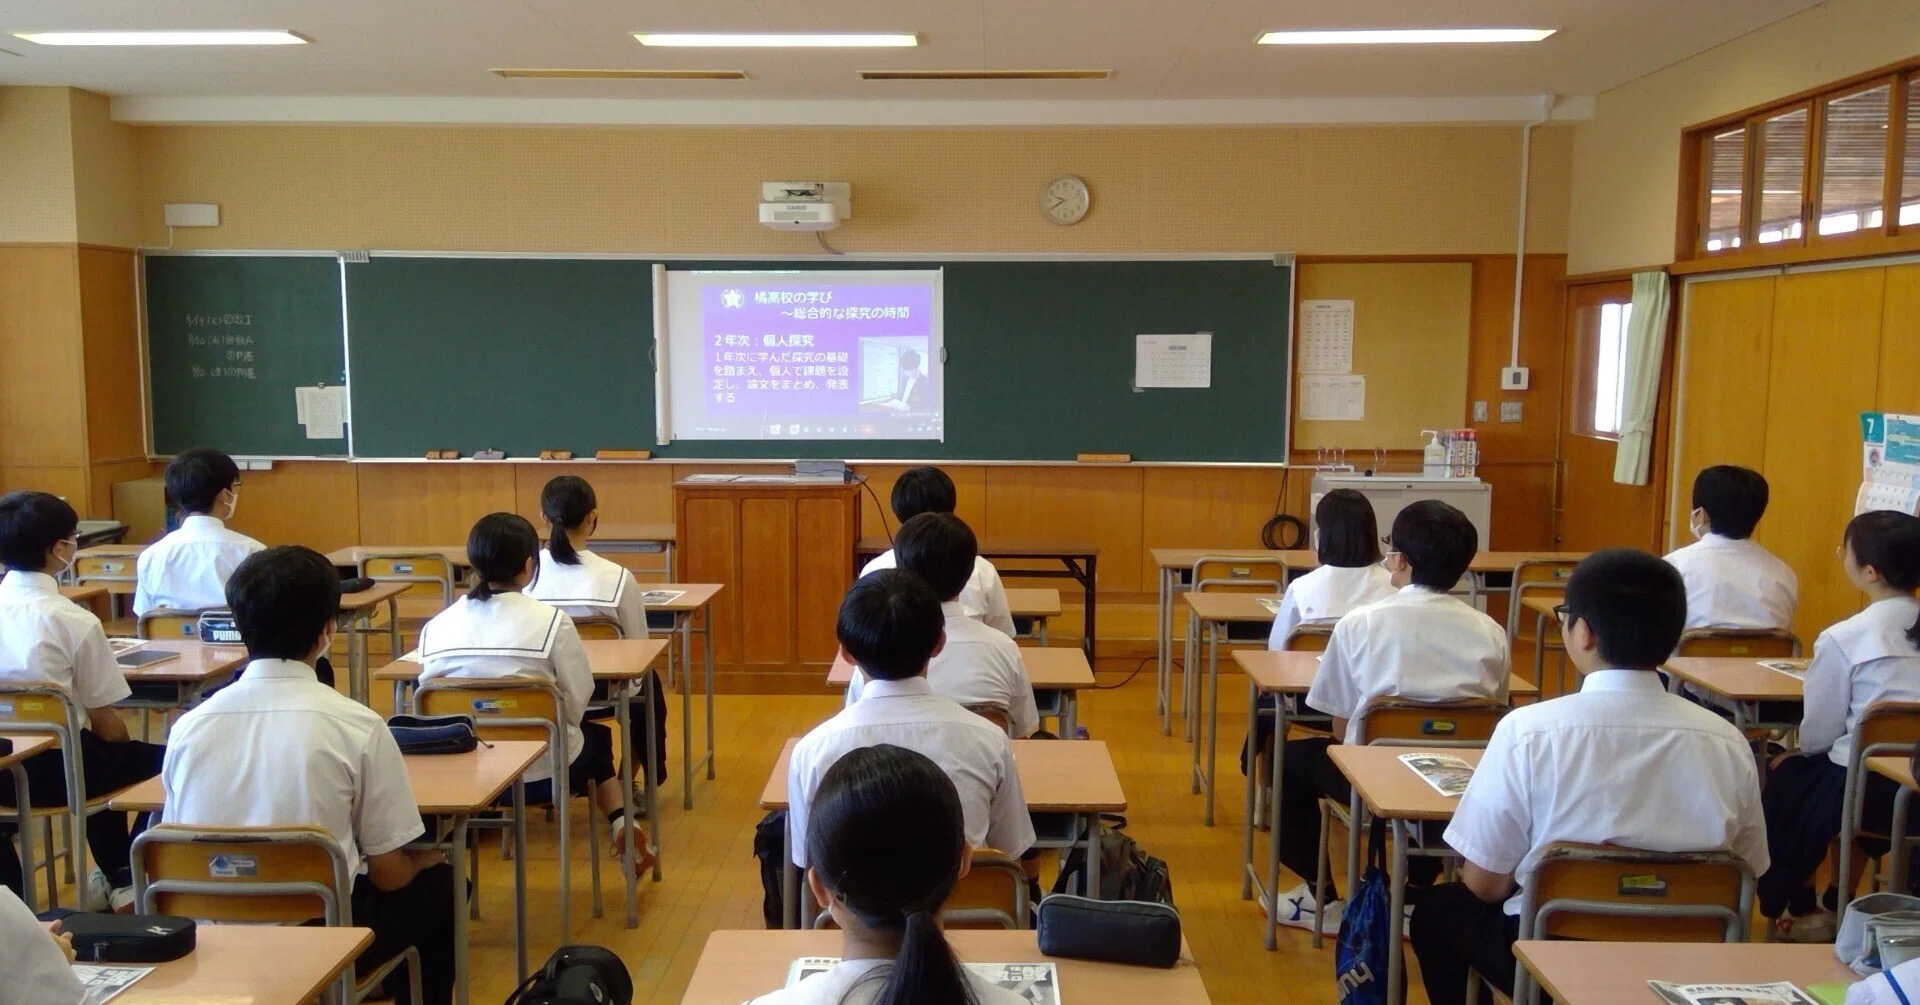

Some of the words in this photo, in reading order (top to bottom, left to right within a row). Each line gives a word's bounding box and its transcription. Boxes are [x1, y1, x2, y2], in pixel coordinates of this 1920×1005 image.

[754, 290, 832, 305] 橘高校の学び
[713, 379, 849, 390] 定し、論文をまとめ、発表
[715, 393, 736, 403] する
[1867, 418, 1875, 434] 7
